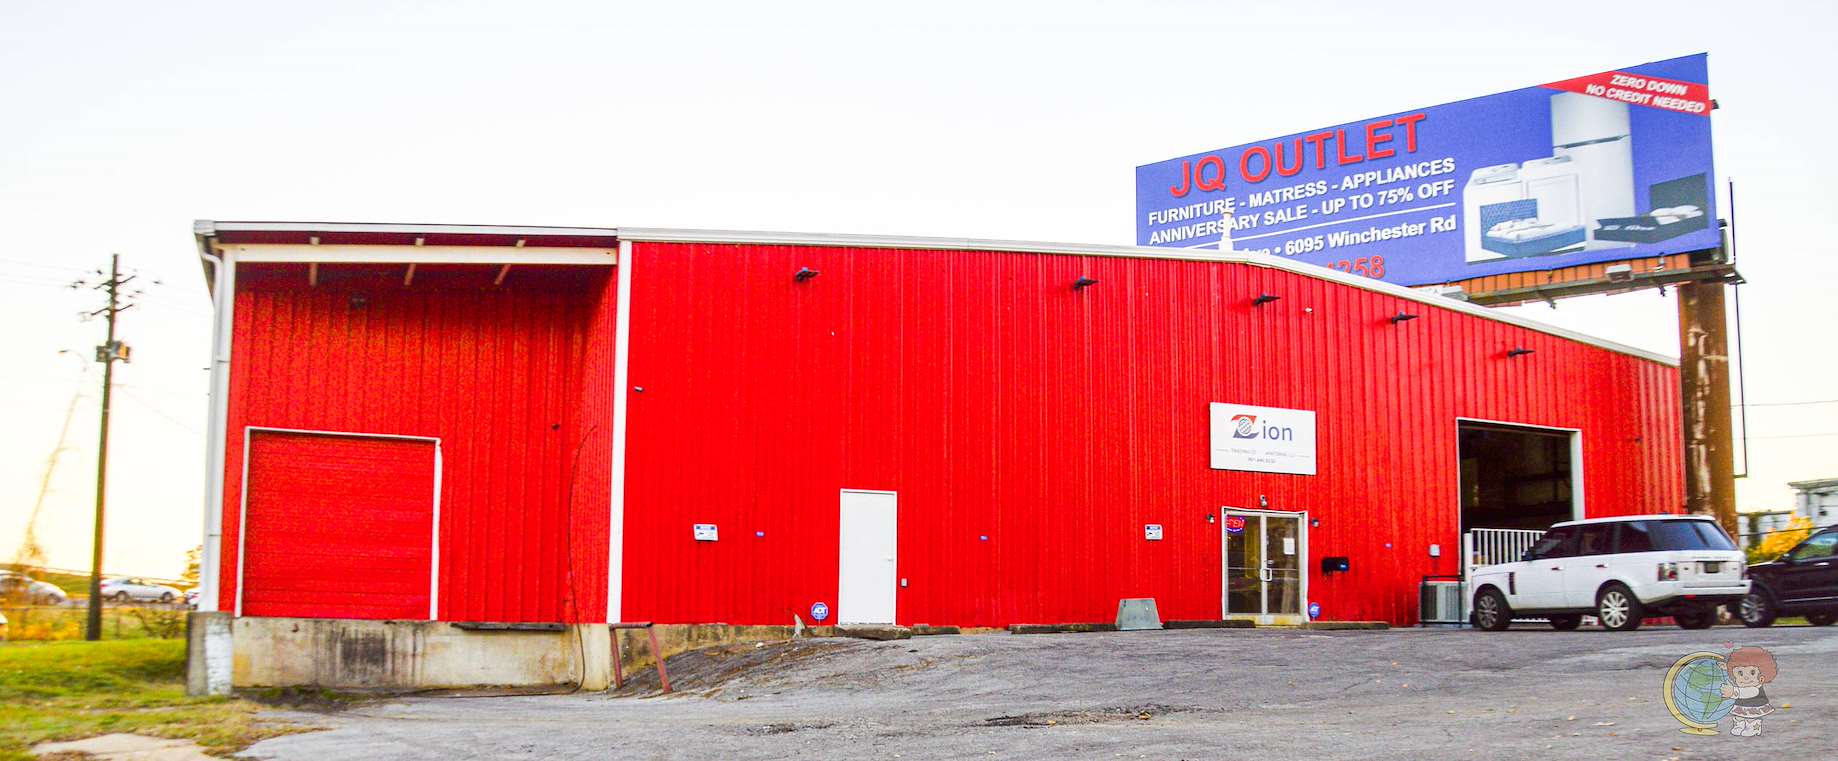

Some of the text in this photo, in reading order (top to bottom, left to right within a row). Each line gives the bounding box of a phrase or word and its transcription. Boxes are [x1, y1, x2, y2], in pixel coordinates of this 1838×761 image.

[1585, 83, 1706, 113] NO CREDIT NEEDED
[1610, 74, 1688, 96] ZERO DOWN
[1170, 113, 1426, 198] JQ OUTLET
[1148, 197, 1235, 226] FURNITURE
[1249, 180, 1328, 208] MATRESS
[1341, 157, 1456, 192] APPLIANCES
[1149, 212, 1260, 246] ANNIVERSARY
[1263, 204, 1308, 226] SALE
[1322, 195, 1347, 216] UP
[1350, 189, 1374, 210] TO
[1378, 186, 1414, 207] 75%
[1417, 179, 1455, 200] OFF
[1285, 235, 1325, 256] 6095
[1327, 221, 1426, 248] Winchester
[1430, 215, 1456, 234] Rd
[1327, 255, 1385, 279] 258
